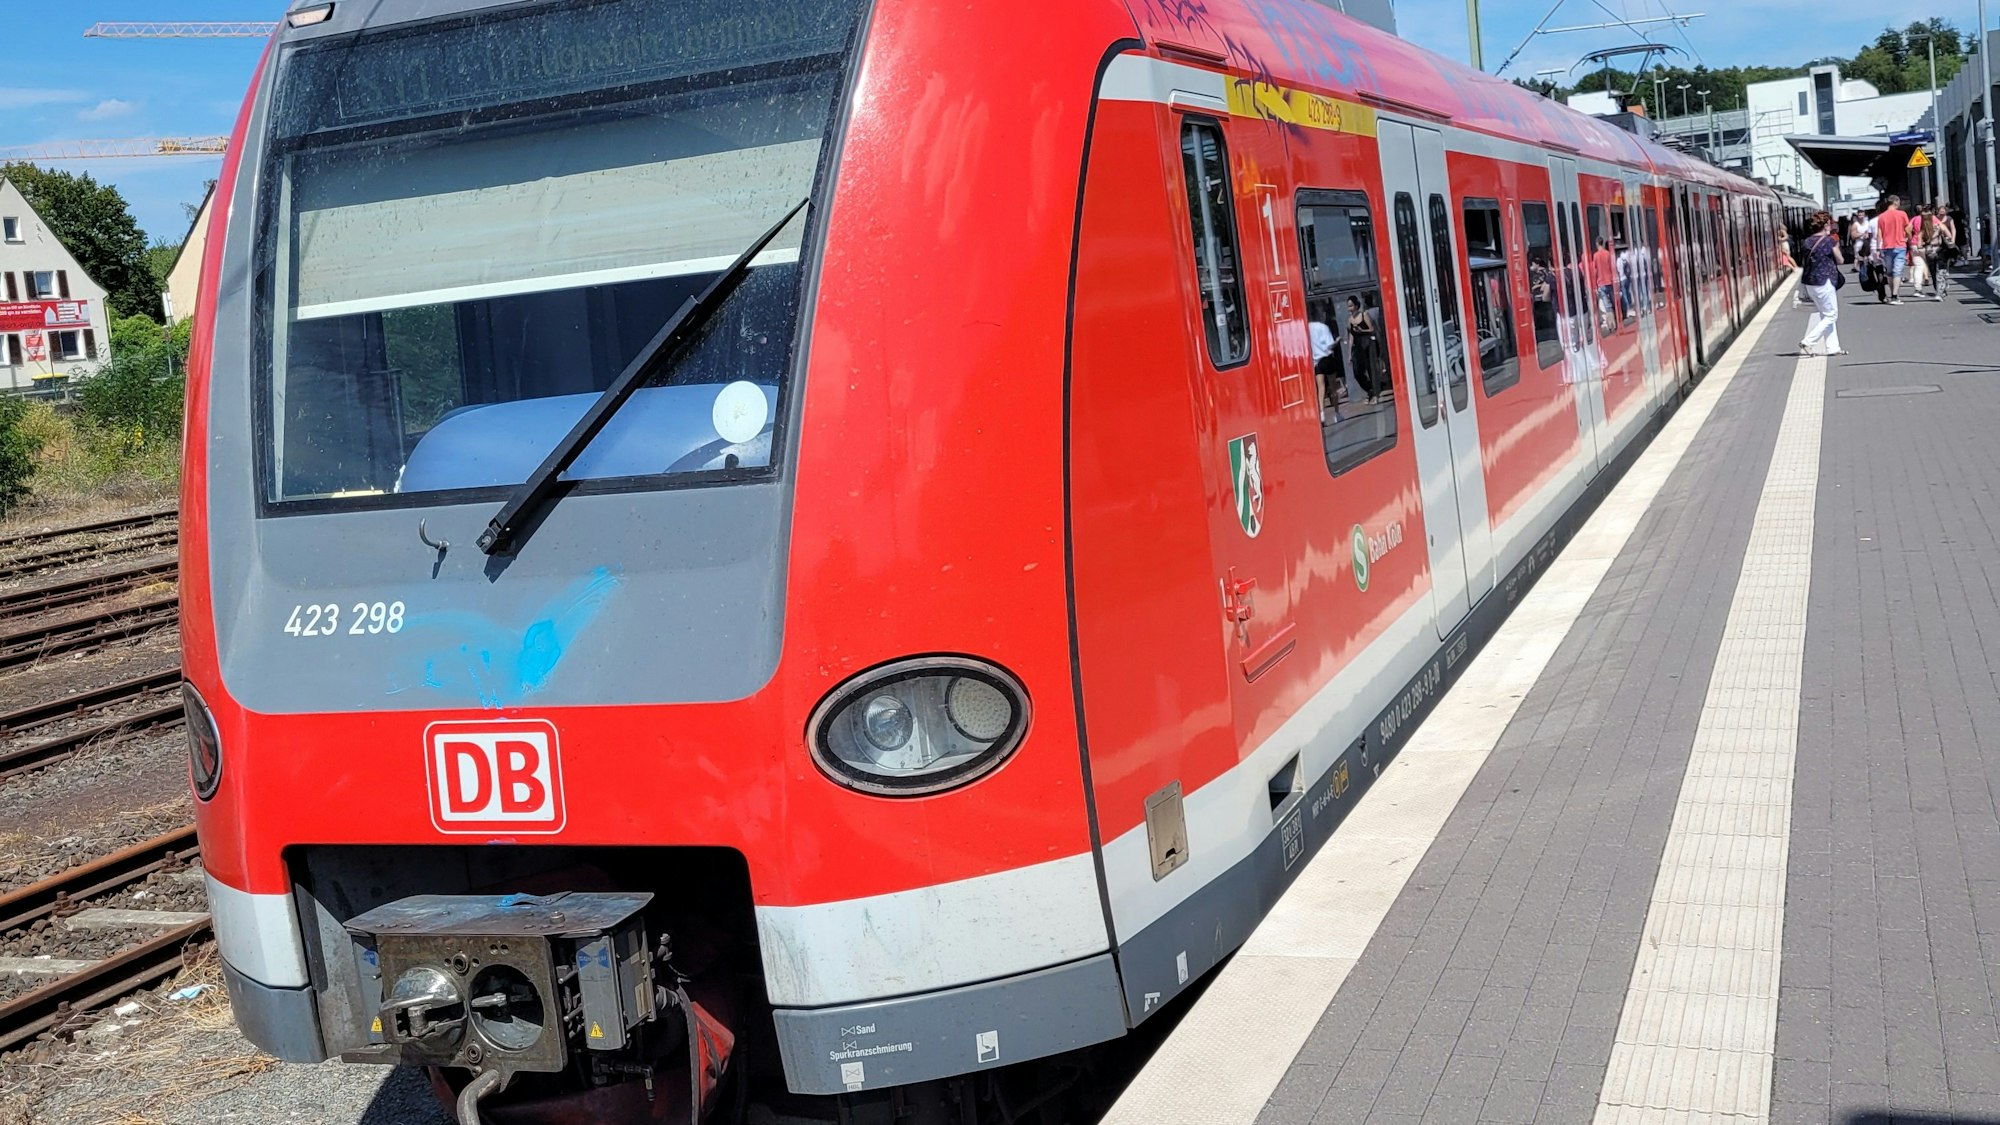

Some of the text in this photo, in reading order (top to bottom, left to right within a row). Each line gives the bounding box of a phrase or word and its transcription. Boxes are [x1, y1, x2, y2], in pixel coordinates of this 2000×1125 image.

[1308, 98, 1321, 122] 423
[1353, 521, 1403, 585] S Bahn Köln
[284, 600, 406, 637] 423 298
[1401, 692, 1412, 720] 423
[443, 740, 546, 814] DB
[856, 1022, 876, 1035] Sand
[829, 1042, 913, 1062] Spurkranzschmierung
